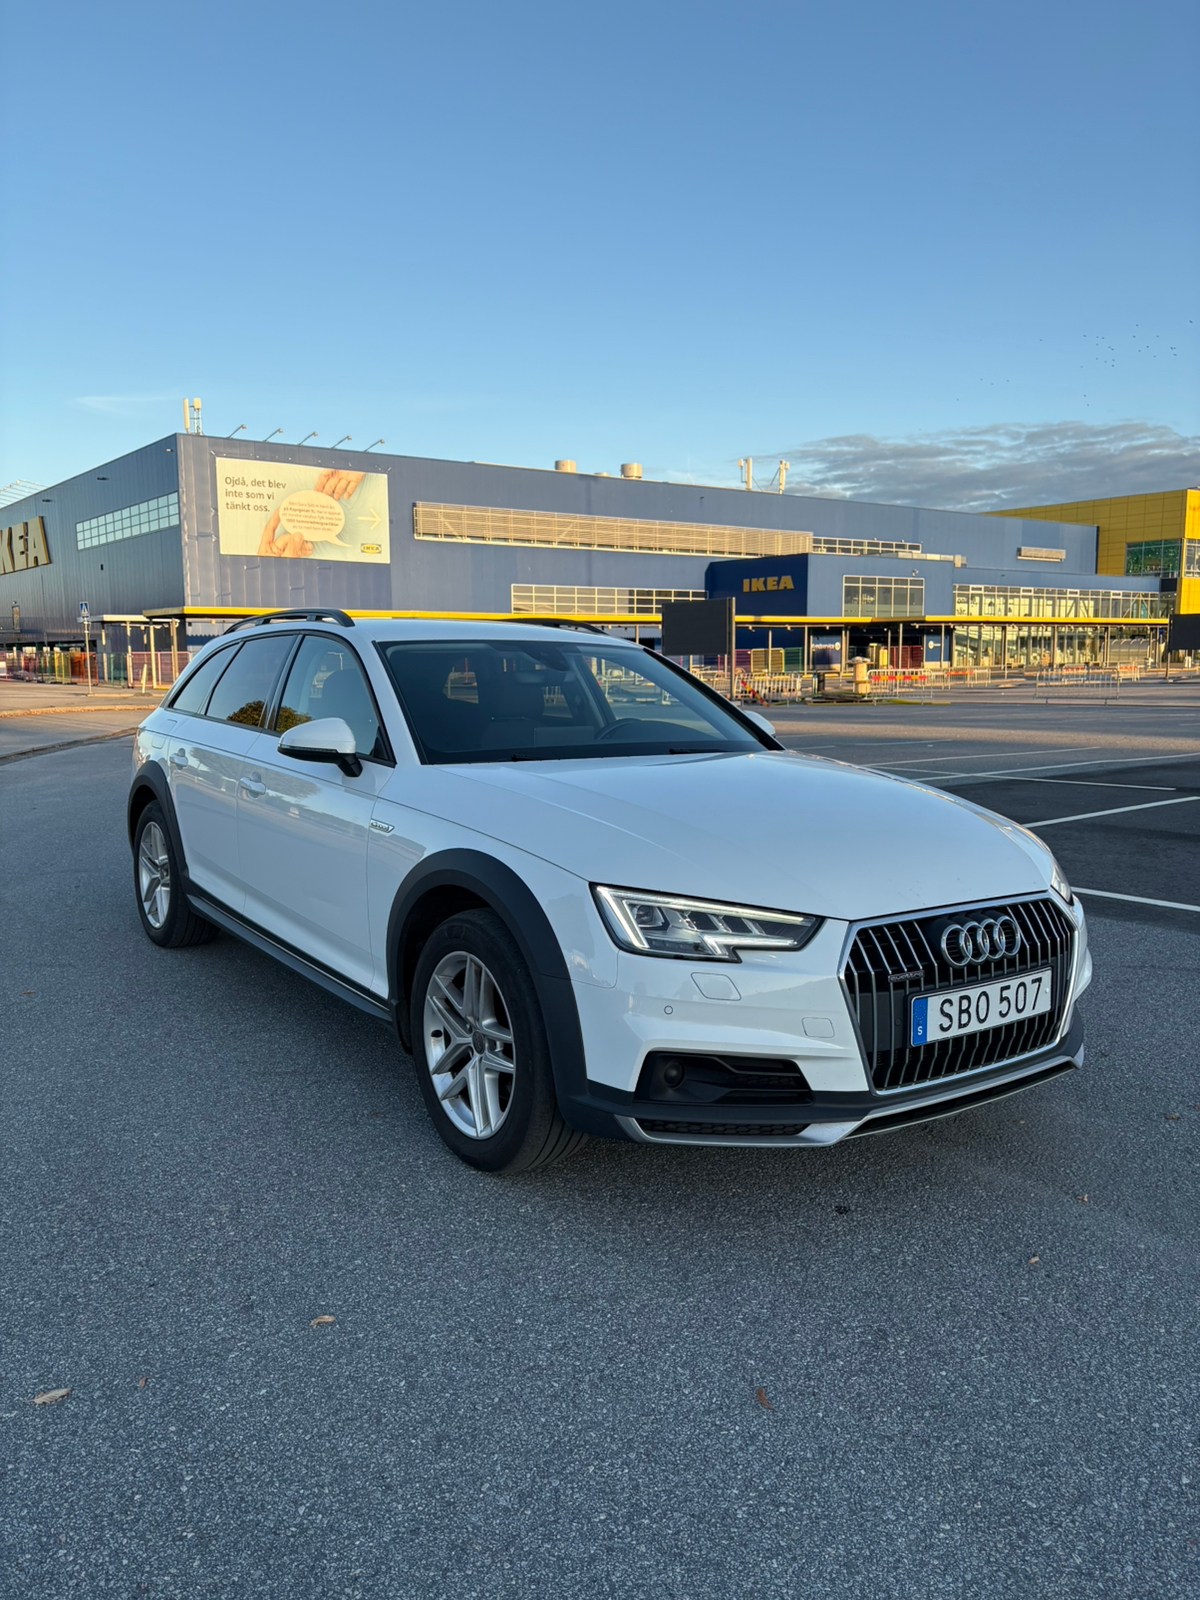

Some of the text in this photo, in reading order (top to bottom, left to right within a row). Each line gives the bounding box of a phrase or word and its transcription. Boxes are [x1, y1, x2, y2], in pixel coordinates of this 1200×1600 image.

[224, 476, 286, 489] Ojdå, det blev
[225, 489, 244, 498] inte
[266, 492, 274, 500] vi
[226, 501, 251, 511] tänkt
[0, 516, 50, 574] KEA
[742, 575, 794, 593] IKEA
[939, 977, 1042, 1032] SBO 507
[918, 1026, 923, 1036] S
